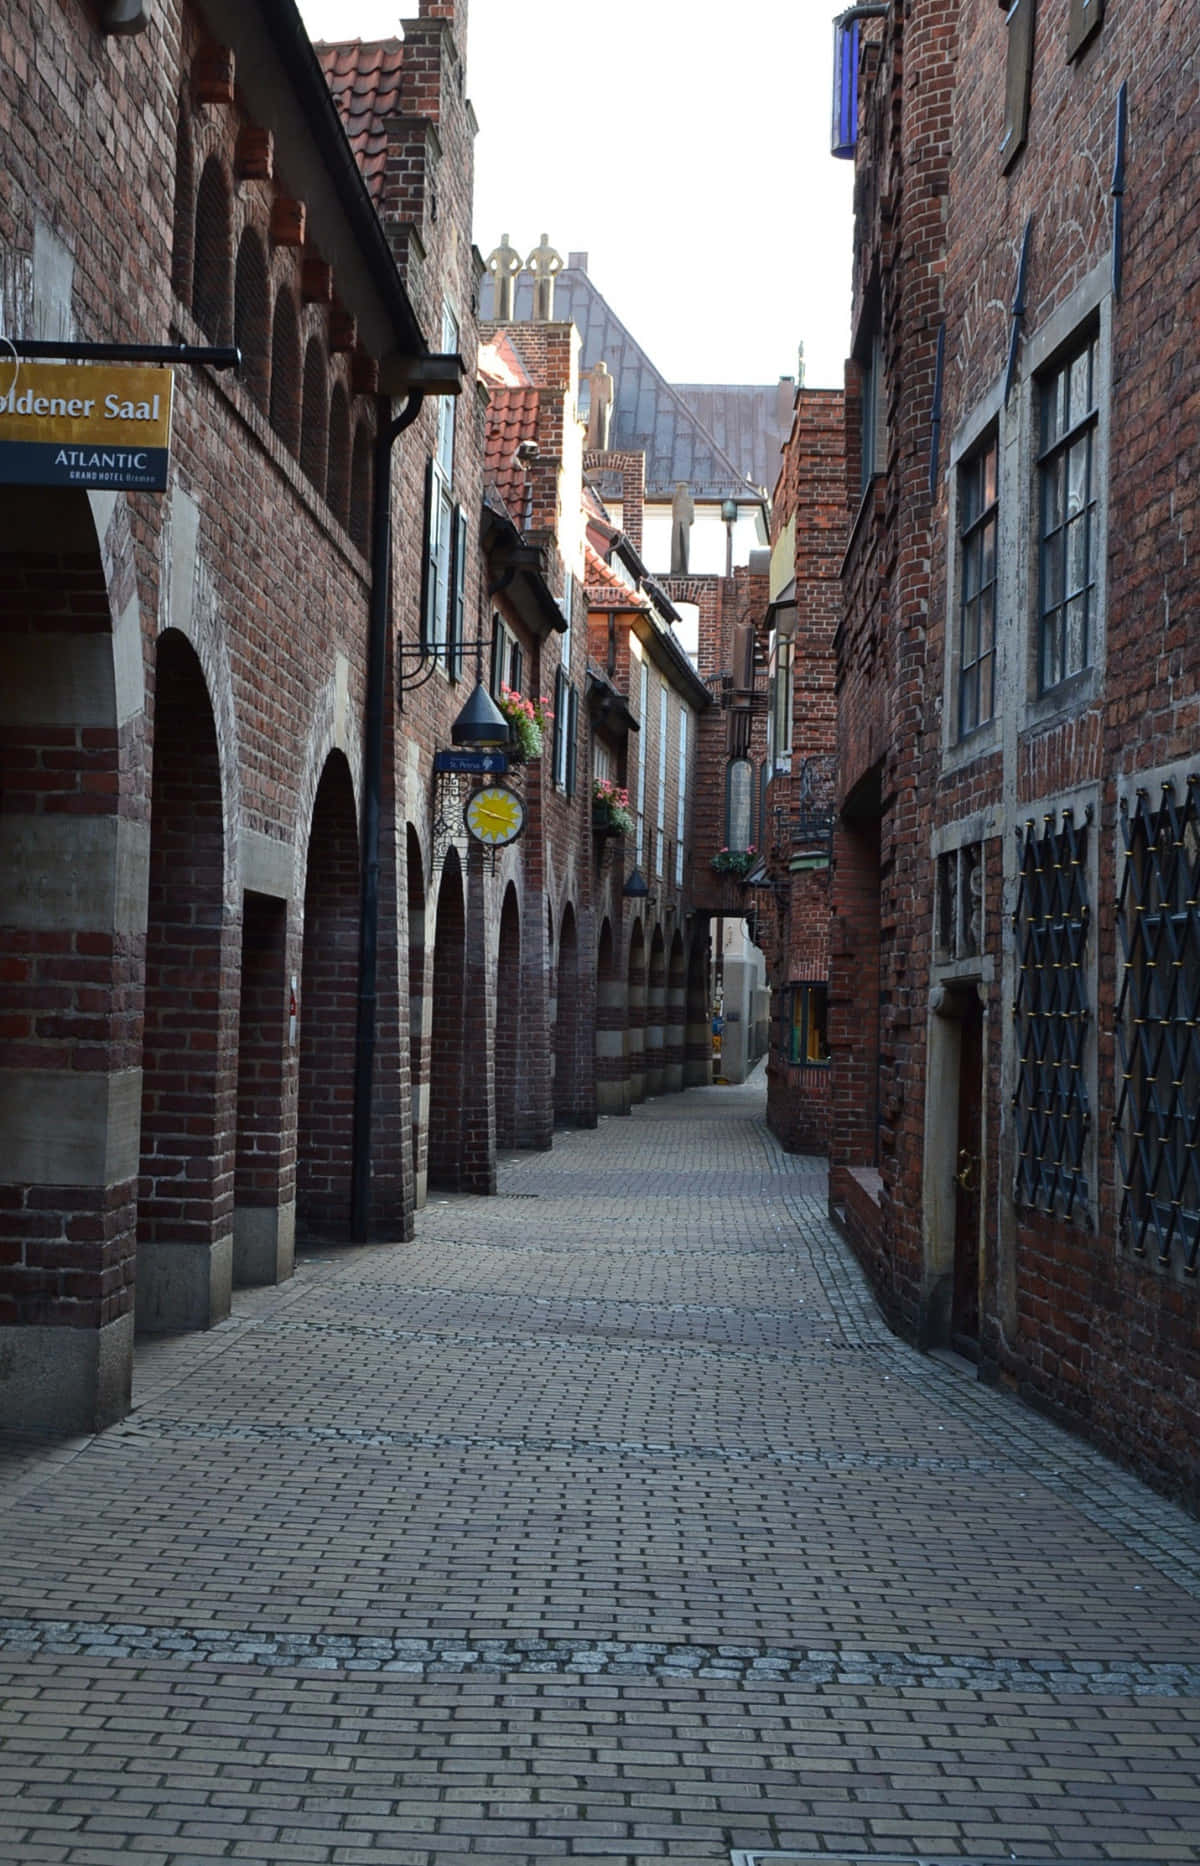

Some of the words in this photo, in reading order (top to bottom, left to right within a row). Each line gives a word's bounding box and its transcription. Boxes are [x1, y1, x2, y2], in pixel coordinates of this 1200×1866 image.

[104, 394, 160, 420] Saal
[54, 449, 147, 469] ATLANTIC
[69, 471, 97, 480] GRAND
[98, 472, 123, 482] HOTEL
